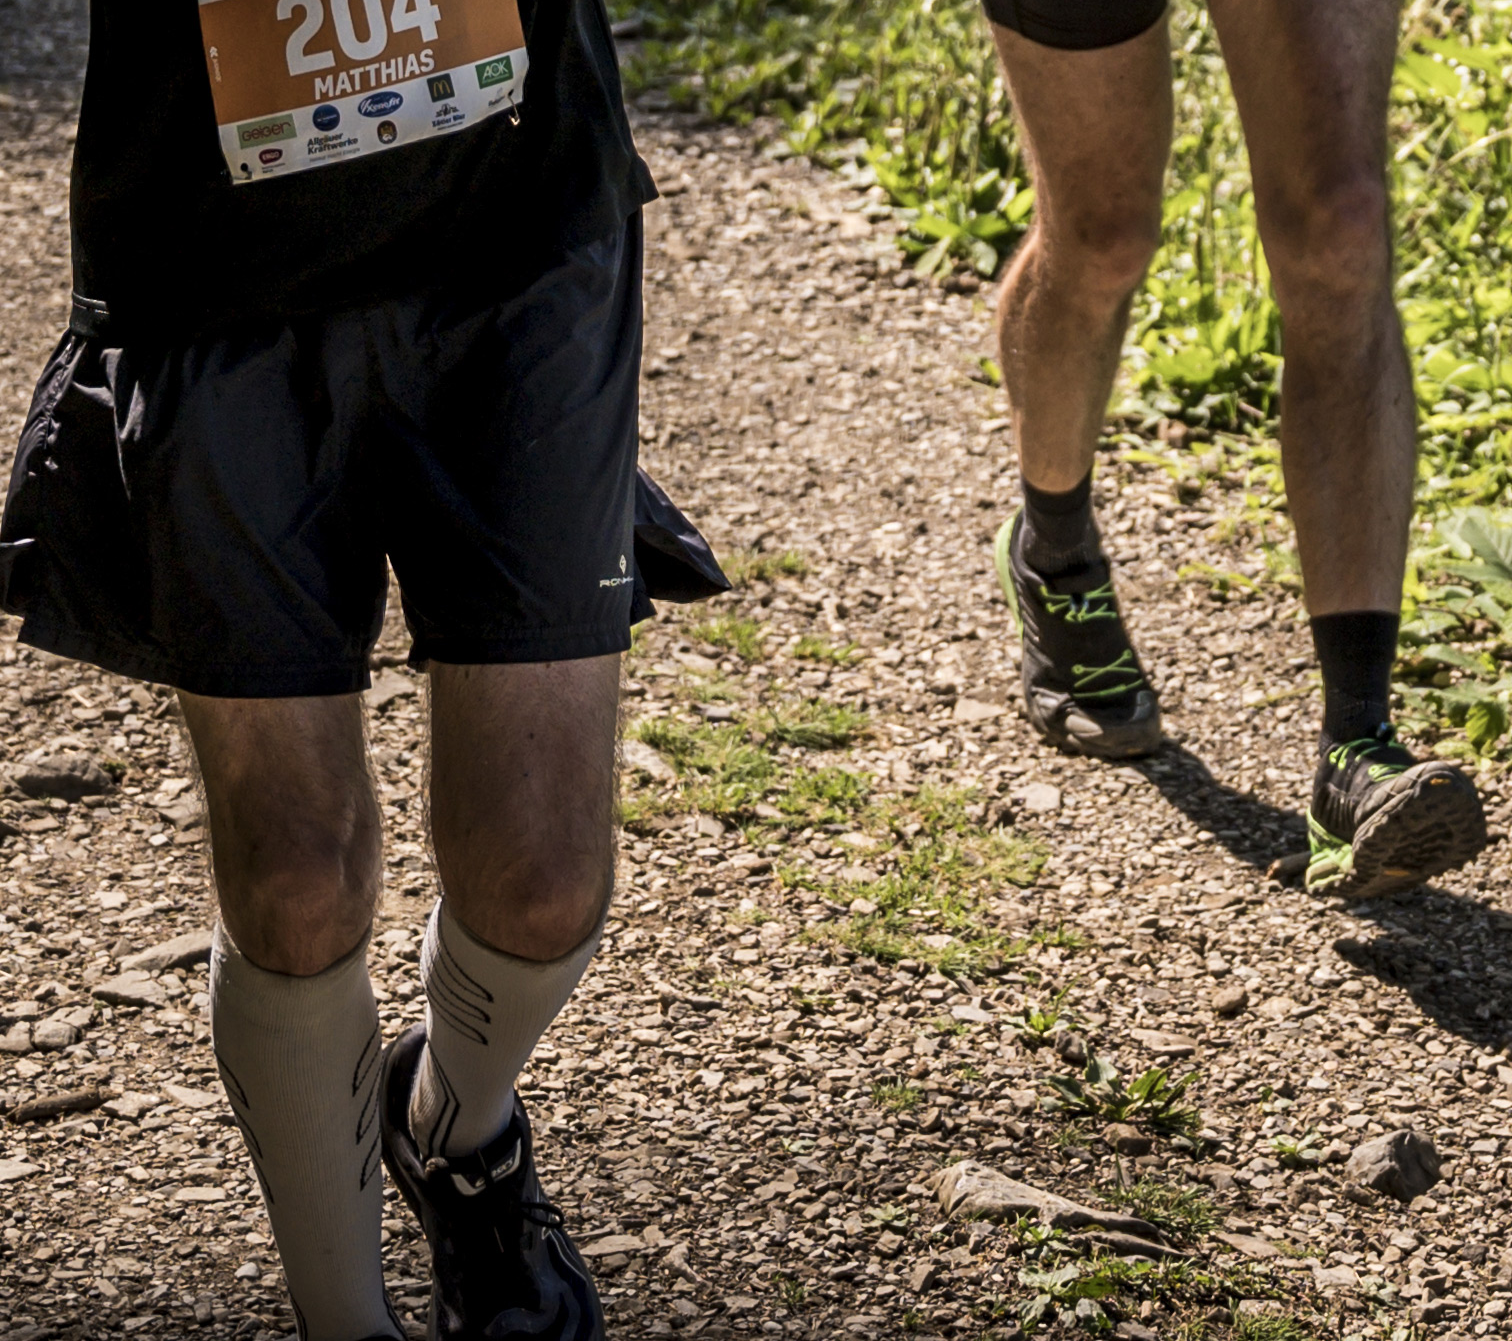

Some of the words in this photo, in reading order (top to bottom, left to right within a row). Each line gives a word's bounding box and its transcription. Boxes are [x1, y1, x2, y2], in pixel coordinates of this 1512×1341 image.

[314, 48, 435, 100] MATTHIAS
[482, 59, 508, 80] AOK
[307, 133, 344, 148] Allgäuer
[307, 137, 358, 155] Kraftwerke
